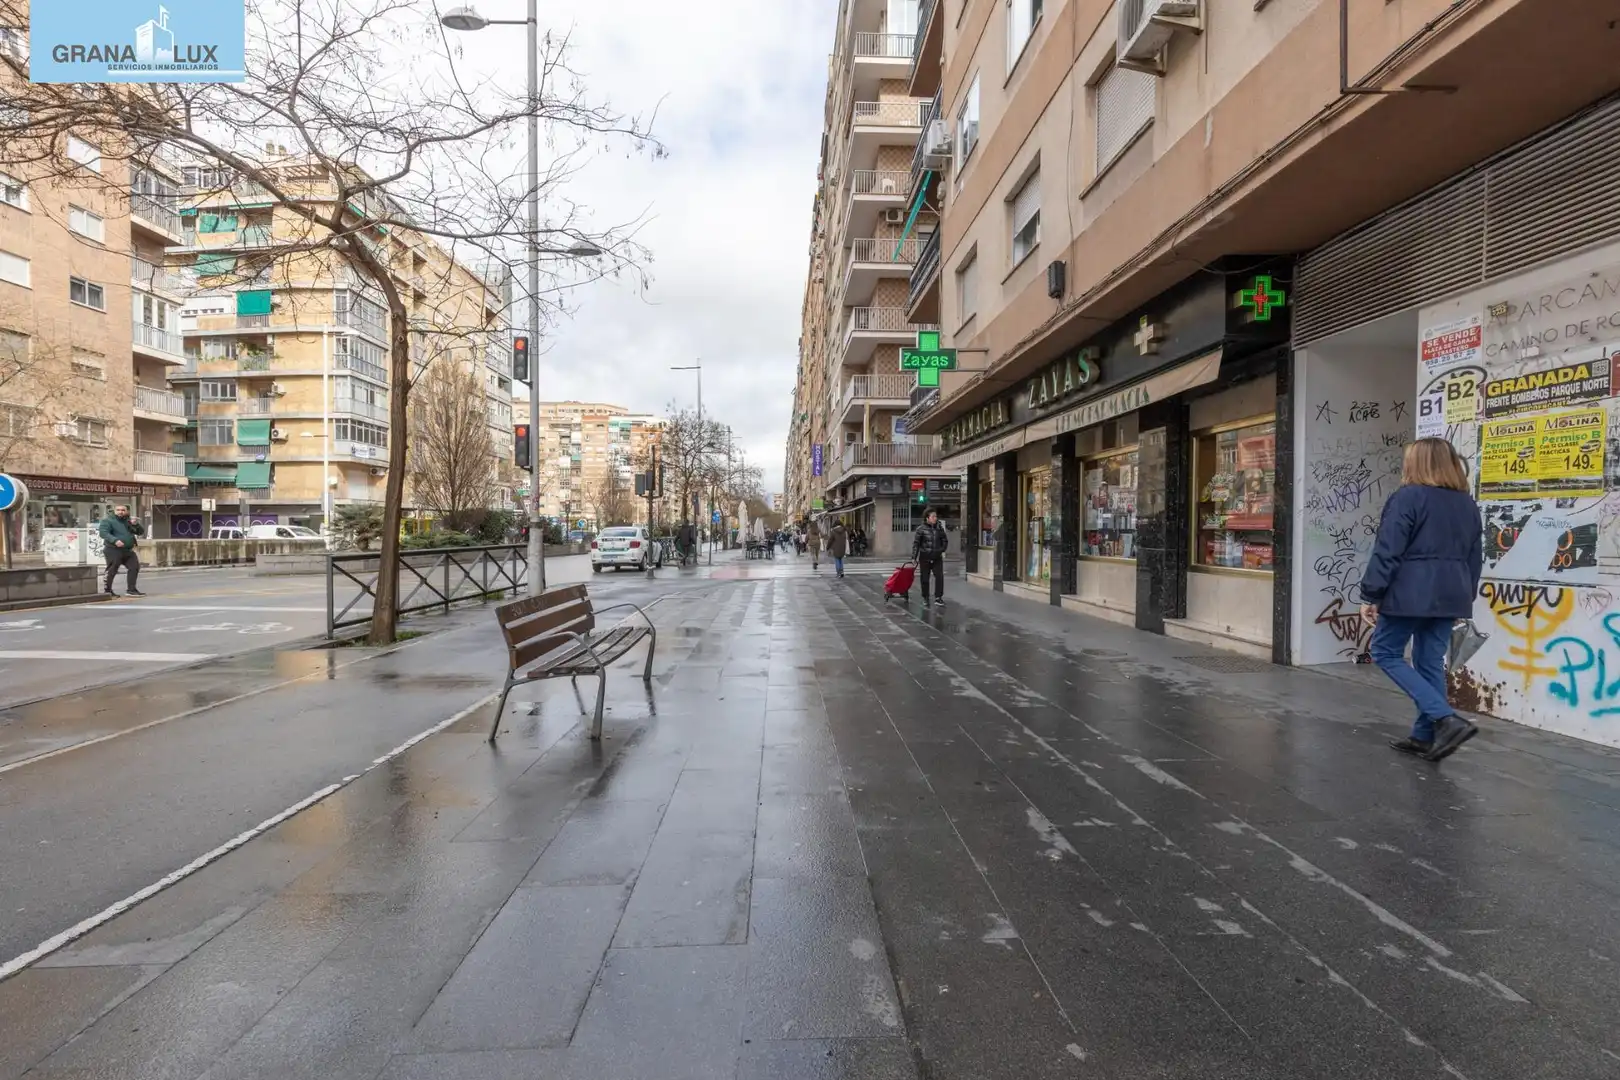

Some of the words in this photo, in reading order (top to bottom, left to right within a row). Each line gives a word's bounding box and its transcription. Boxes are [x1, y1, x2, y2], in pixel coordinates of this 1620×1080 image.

[1426, 339, 1440, 348] SE
[1441, 327, 1477, 343] VENDE
[1485, 327, 1558, 357] CAMINO
[1565, 319, 1590, 338] DE
[903, 352, 949, 367] Zayas
[1028, 348, 1096, 409] ZAYAS
[1486, 363, 1590, 397] GRANADA
[1447, 379, 1475, 402] B2
[1486, 393, 1510, 409] FRENTE
[1551, 382, 1581, 397] PARQUE
[1582, 376, 1609, 392] NORTE
[1420, 396, 1443, 417] B1
[1488, 424, 1535, 437] MOLINA
[1545, 416, 1600, 430] MOLINA
[1485, 440, 1524, 450] Permiso
[1528, 437, 1535, 446] B
[1541, 433, 1587, 445] Permiso
[1591, 430, 1601, 439] B
[24, 479, 63, 490] PRODUCTOS
[63, 481, 72, 490] DE
